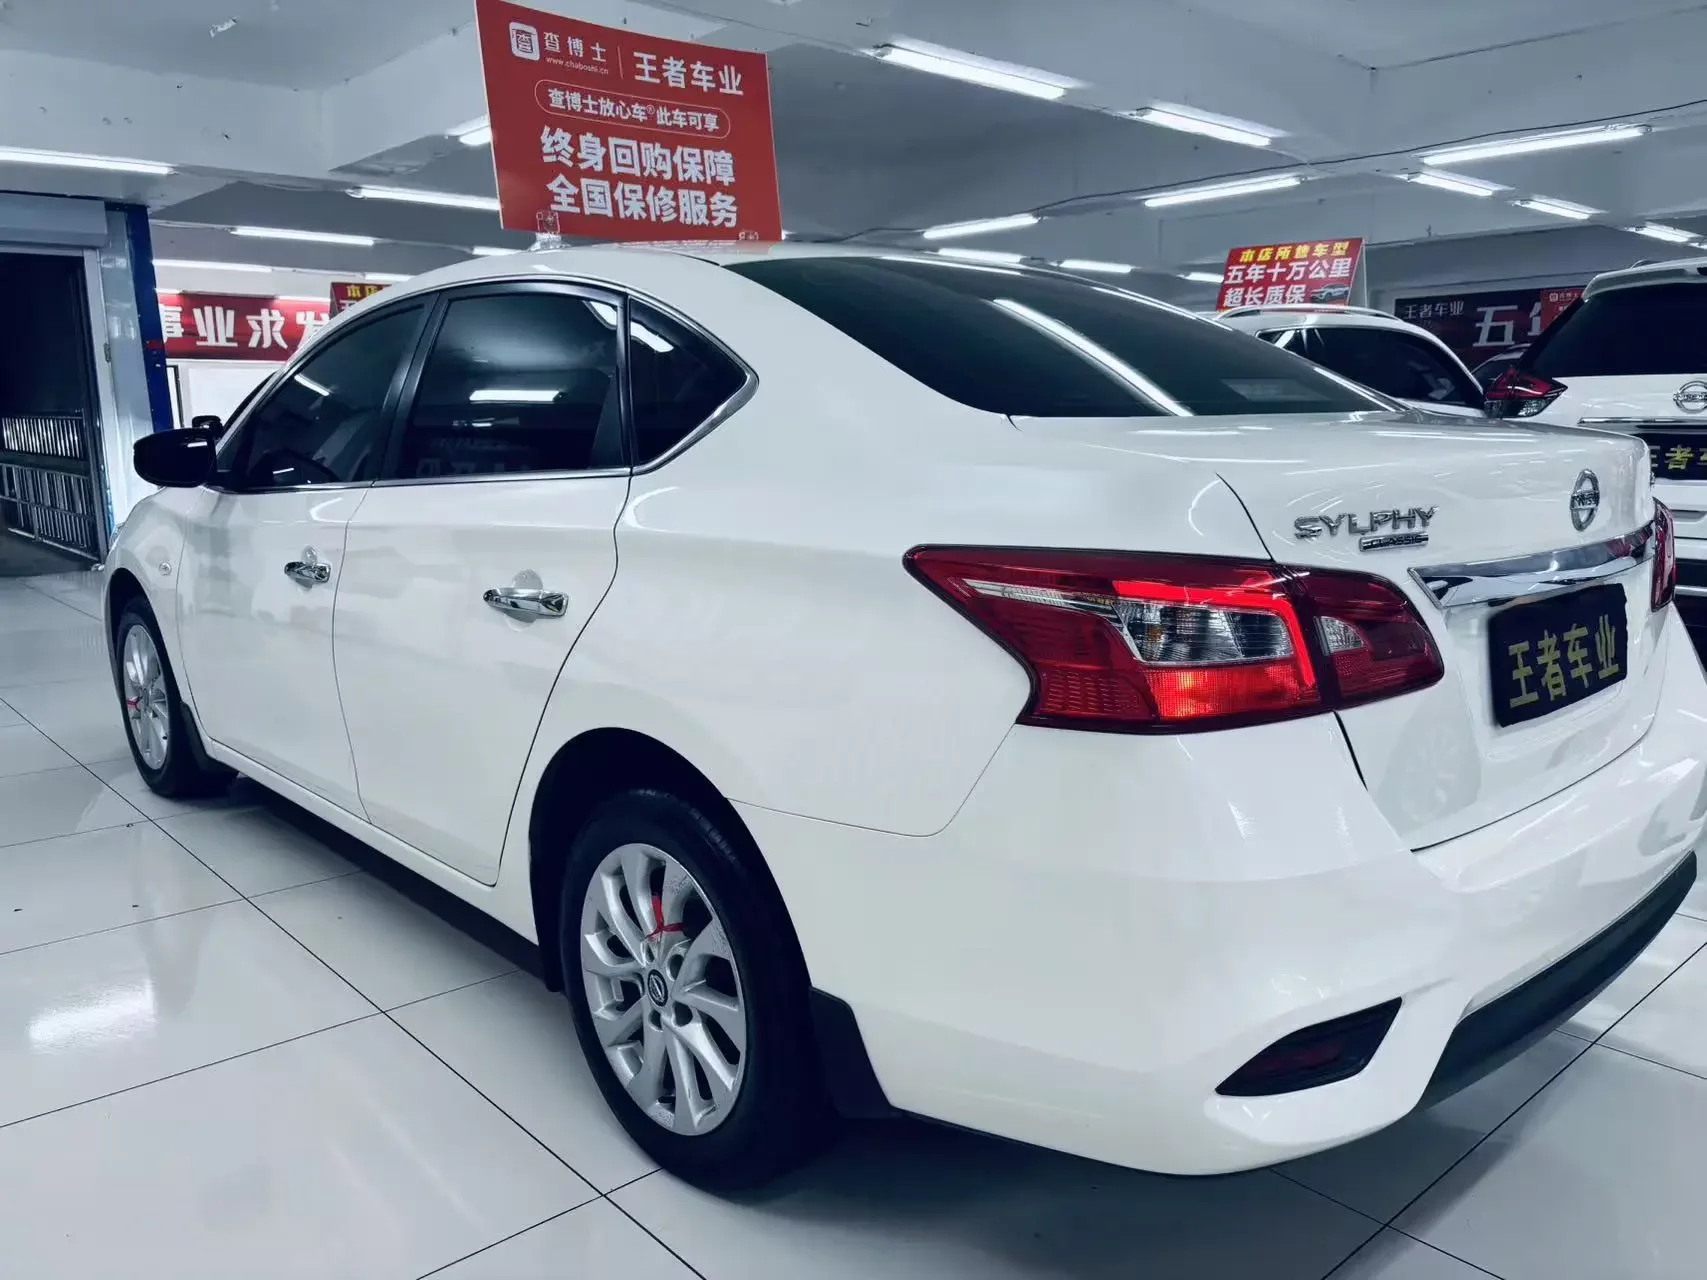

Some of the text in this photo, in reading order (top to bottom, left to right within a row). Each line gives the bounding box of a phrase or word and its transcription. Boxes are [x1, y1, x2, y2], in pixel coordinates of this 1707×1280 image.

[543, 31, 607, 62] 查博士
[545, 57, 609, 75] www.chaboshi.cn
[633, 51, 744, 96] 王者车业
[540, 125, 735, 186] 终身回购保障
[546, 173, 737, 228] 全国保修服务
[1225, 257, 1352, 284] 五年十万公里
[1239, 241, 1349, 263] 本店所售车型
[1223, 284, 1306, 308] 超长质保
[1294, 496, 1439, 539] SYLPHY
[1508, 614, 1620, 708] 王者车业
